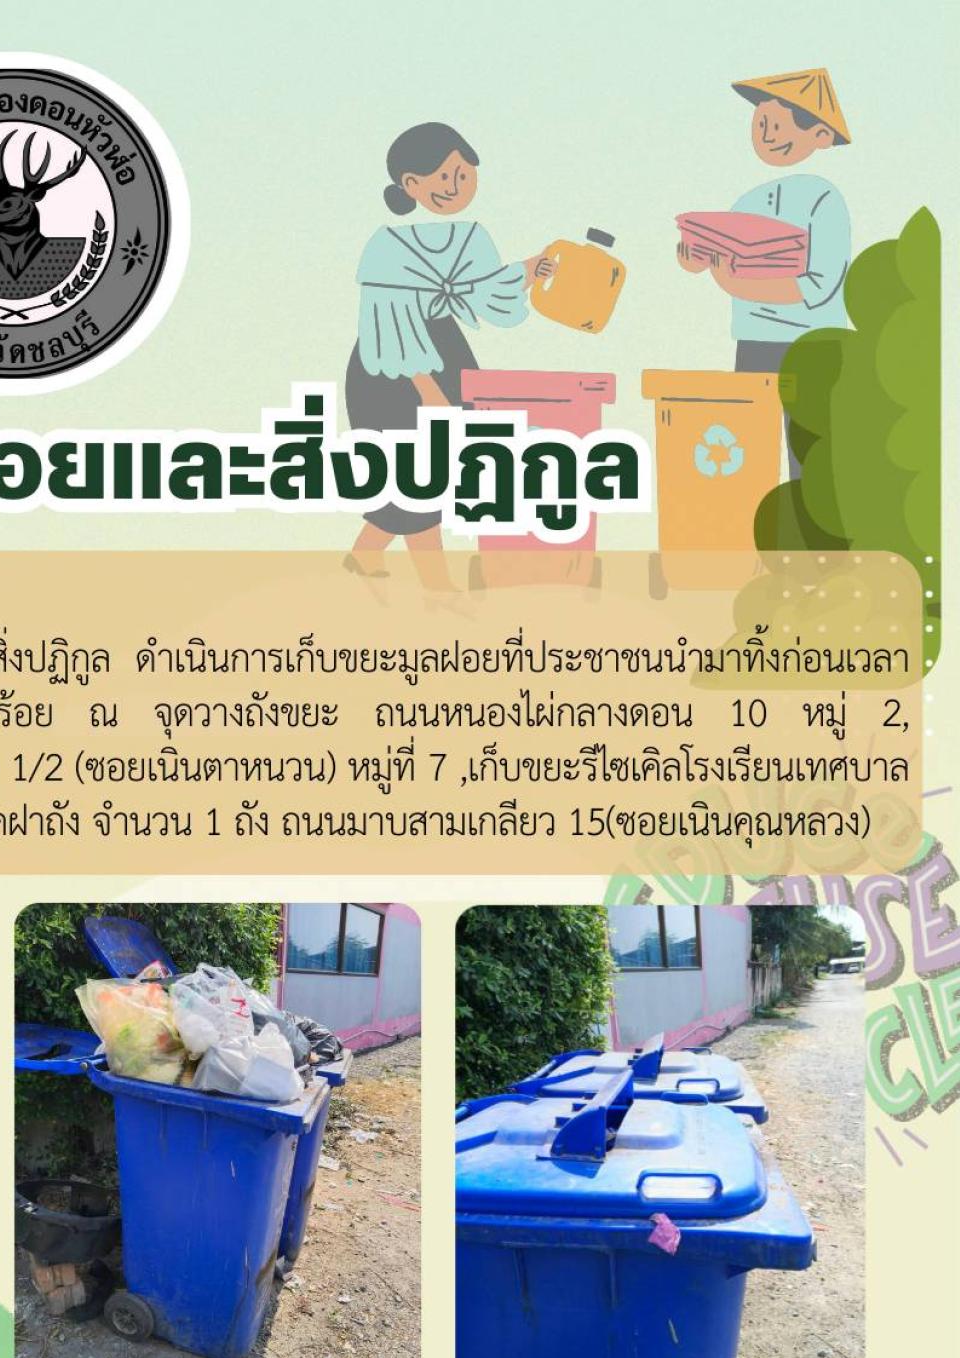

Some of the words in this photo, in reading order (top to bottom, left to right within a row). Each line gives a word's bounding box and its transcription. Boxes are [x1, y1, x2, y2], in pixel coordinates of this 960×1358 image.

[136, 624, 909, 686] ดำเนินการเก็บขยะมูลฝอยที่ประชาชนนำมาทิ้งก่อนเวลา
[90, 703, 118, 727] ณ
[154, 691, 338, 740] จุดวางถังขยะ
[375, 689, 693, 728] ถนนหนองไผ่กลางดอน
[732, 698, 767, 728] 10
[802, 691, 846, 741] หมู่
[882, 698, 909, 733] 2,
[13, 752, 63, 784] 1/2
[75, 746, 336, 785] (ซอยเนินตาหนวน)
[348, 738, 415, 795] หมู่ที่
[429, 753, 447, 783] 7
[92, 800, 192, 836] จำนวน
[207, 807, 221, 836] 1
[235, 799, 269, 836] ถัง
[282, 798, 555, 836] ถนนมาบสามเกลียว
[571, 800, 871, 849] 15(ซอยเนินคุณหลวง)
